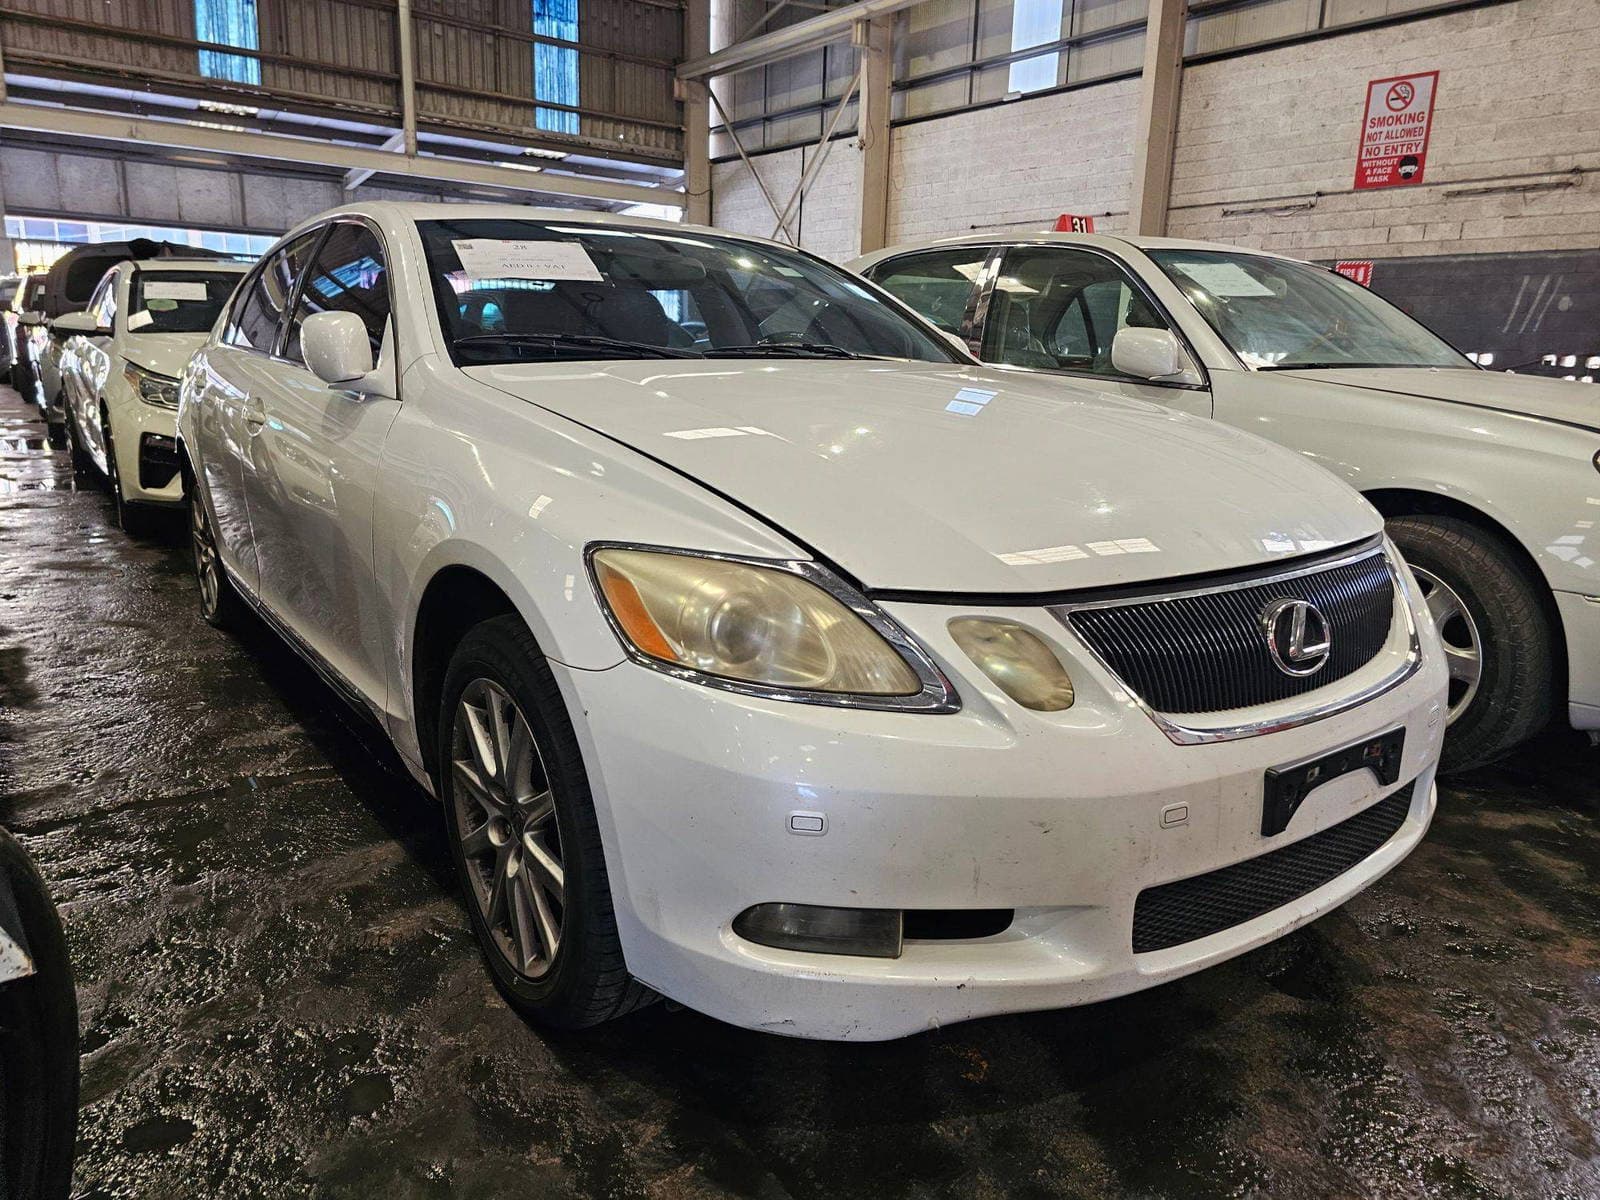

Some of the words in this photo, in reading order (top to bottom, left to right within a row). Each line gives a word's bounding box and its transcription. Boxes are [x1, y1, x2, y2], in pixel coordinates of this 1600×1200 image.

[1369, 111, 1425, 129] SMOKING
[1366, 131, 1382, 142] NOT
[1384, 126, 1424, 141] ALLOWED
[1365, 146, 1381, 157] NO
[1384, 142, 1421, 155] ENTRY
[1362, 158, 1398, 168] WITHOUT
[1365, 168, 1371, 176] A
[1372, 167, 1392, 175] FACE
[1366, 175, 1389, 183] MASK
[1072, 217, 1087, 233] 31
